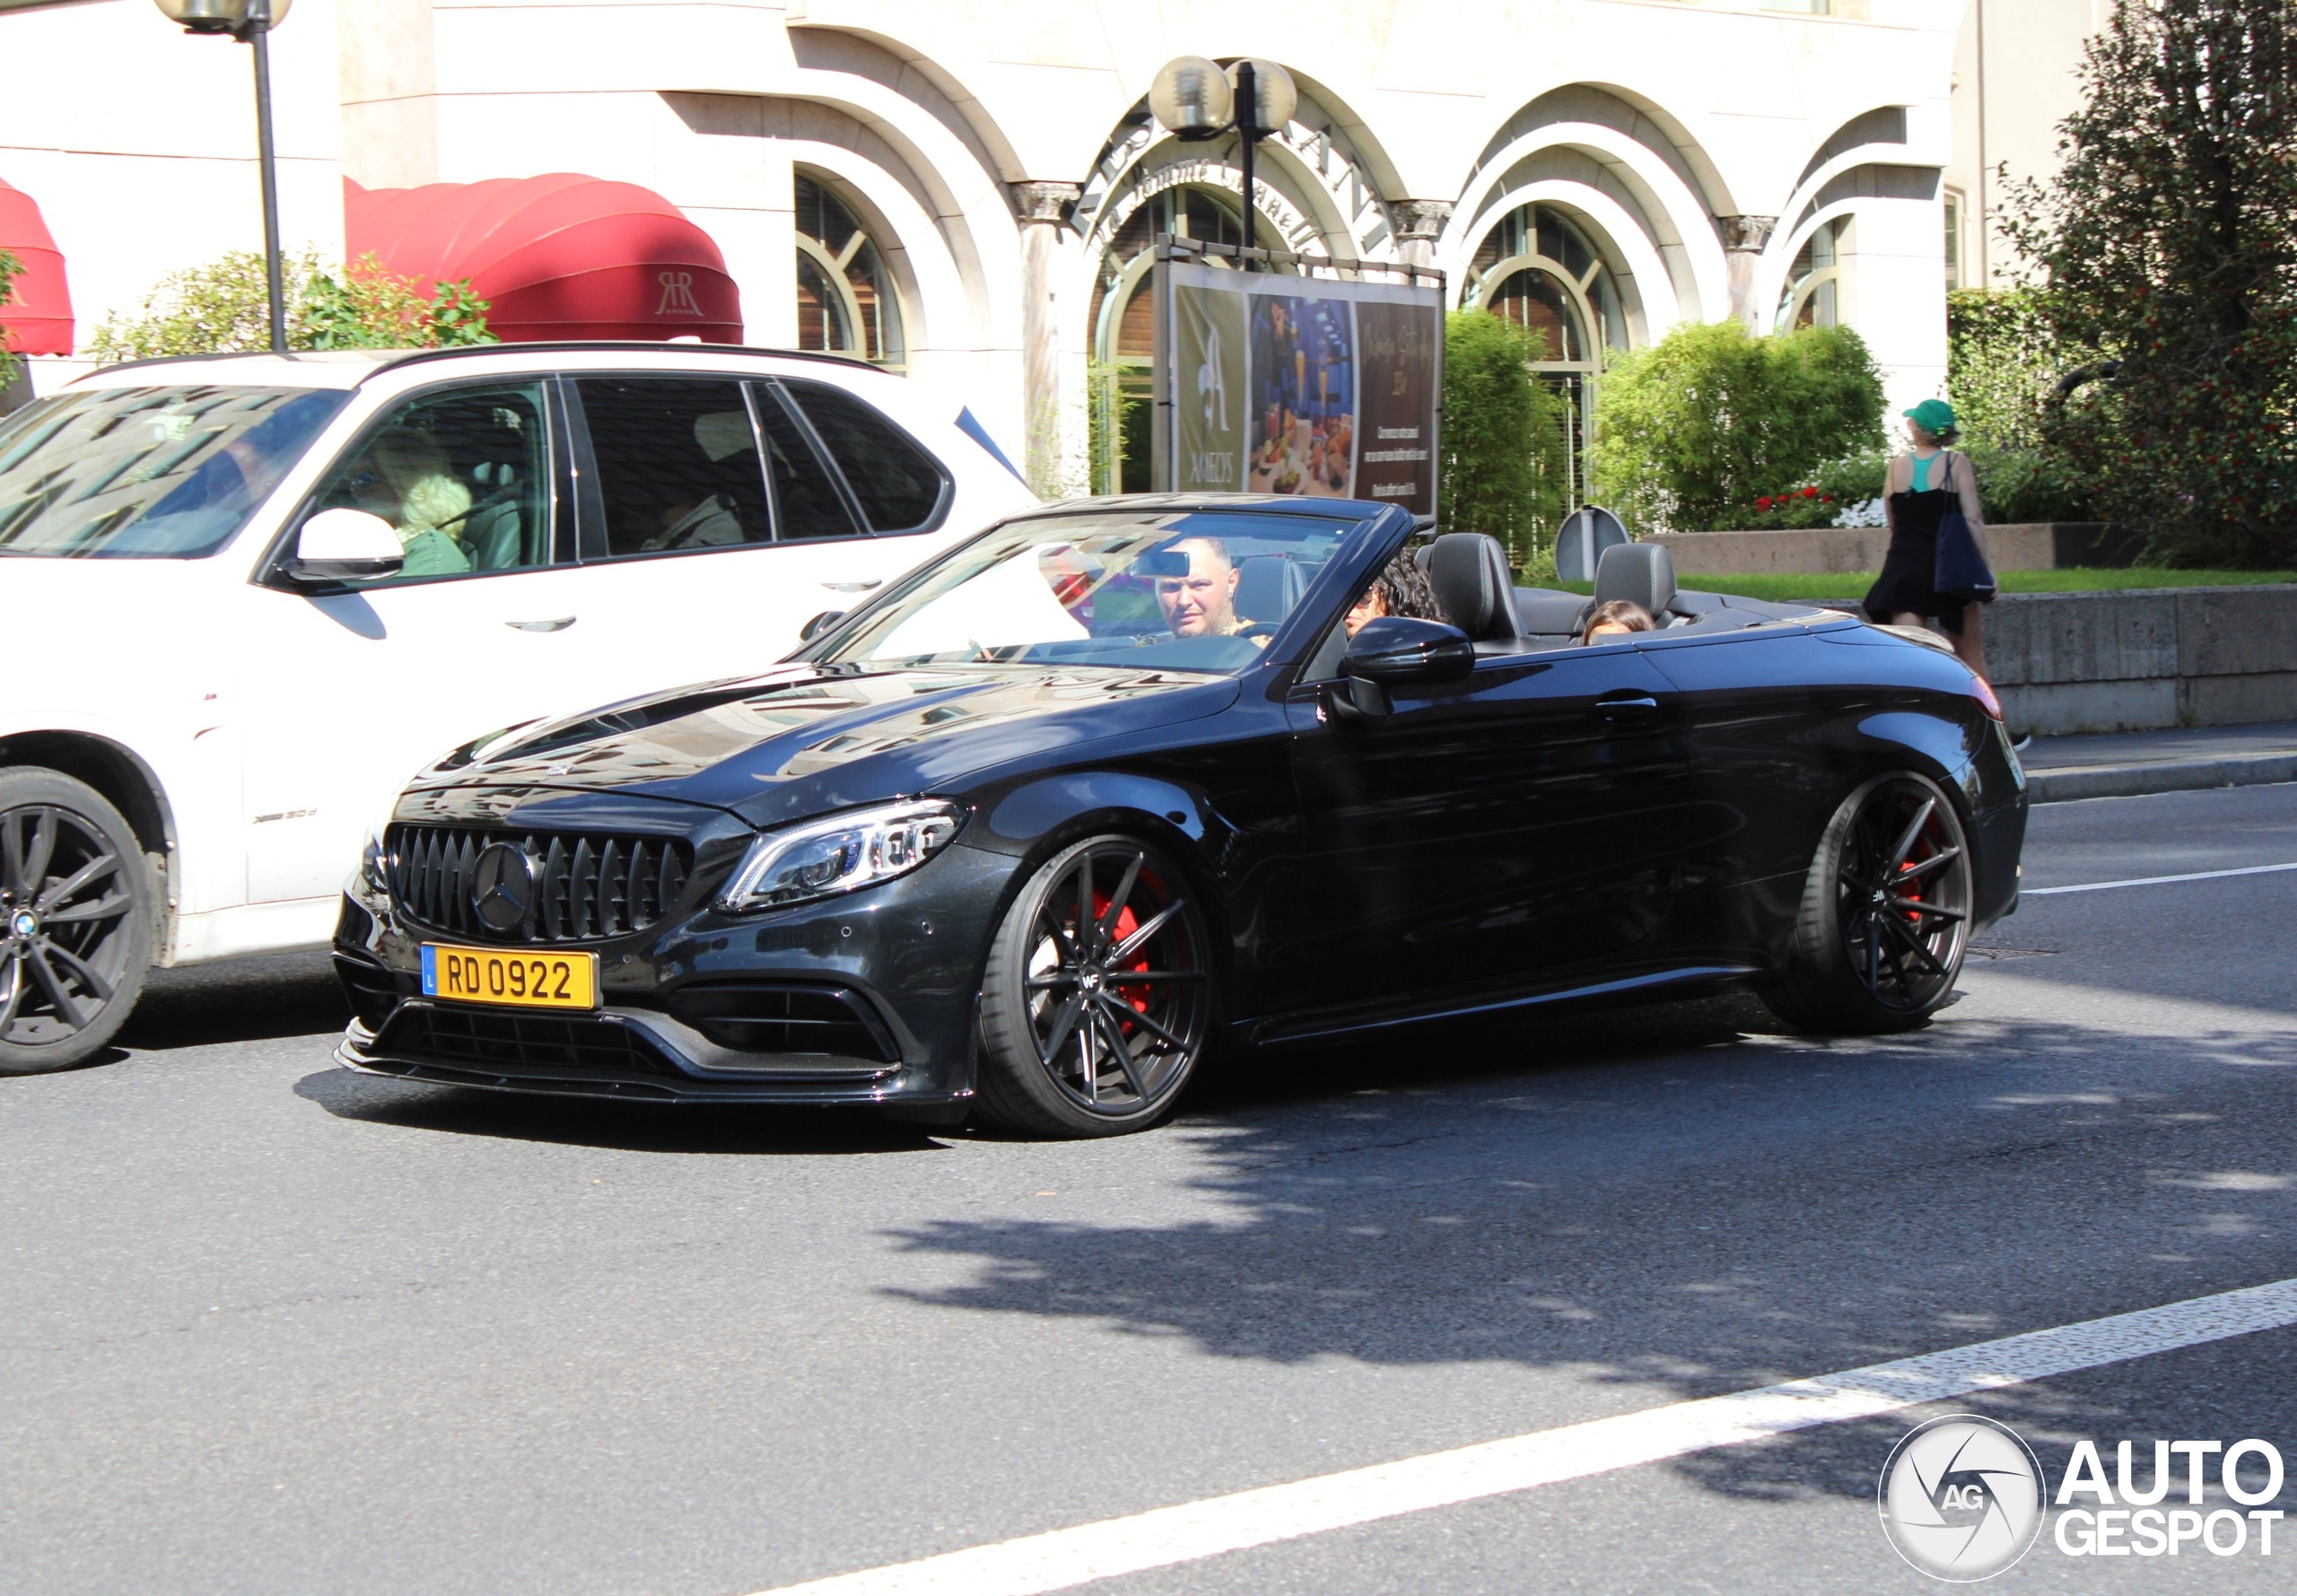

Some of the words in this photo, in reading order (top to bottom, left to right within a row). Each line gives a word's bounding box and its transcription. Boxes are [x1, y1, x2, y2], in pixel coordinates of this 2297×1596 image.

[427, 974, 433, 988] L
[448, 955, 480, 994] RD
[488, 959, 572, 999] 0922
